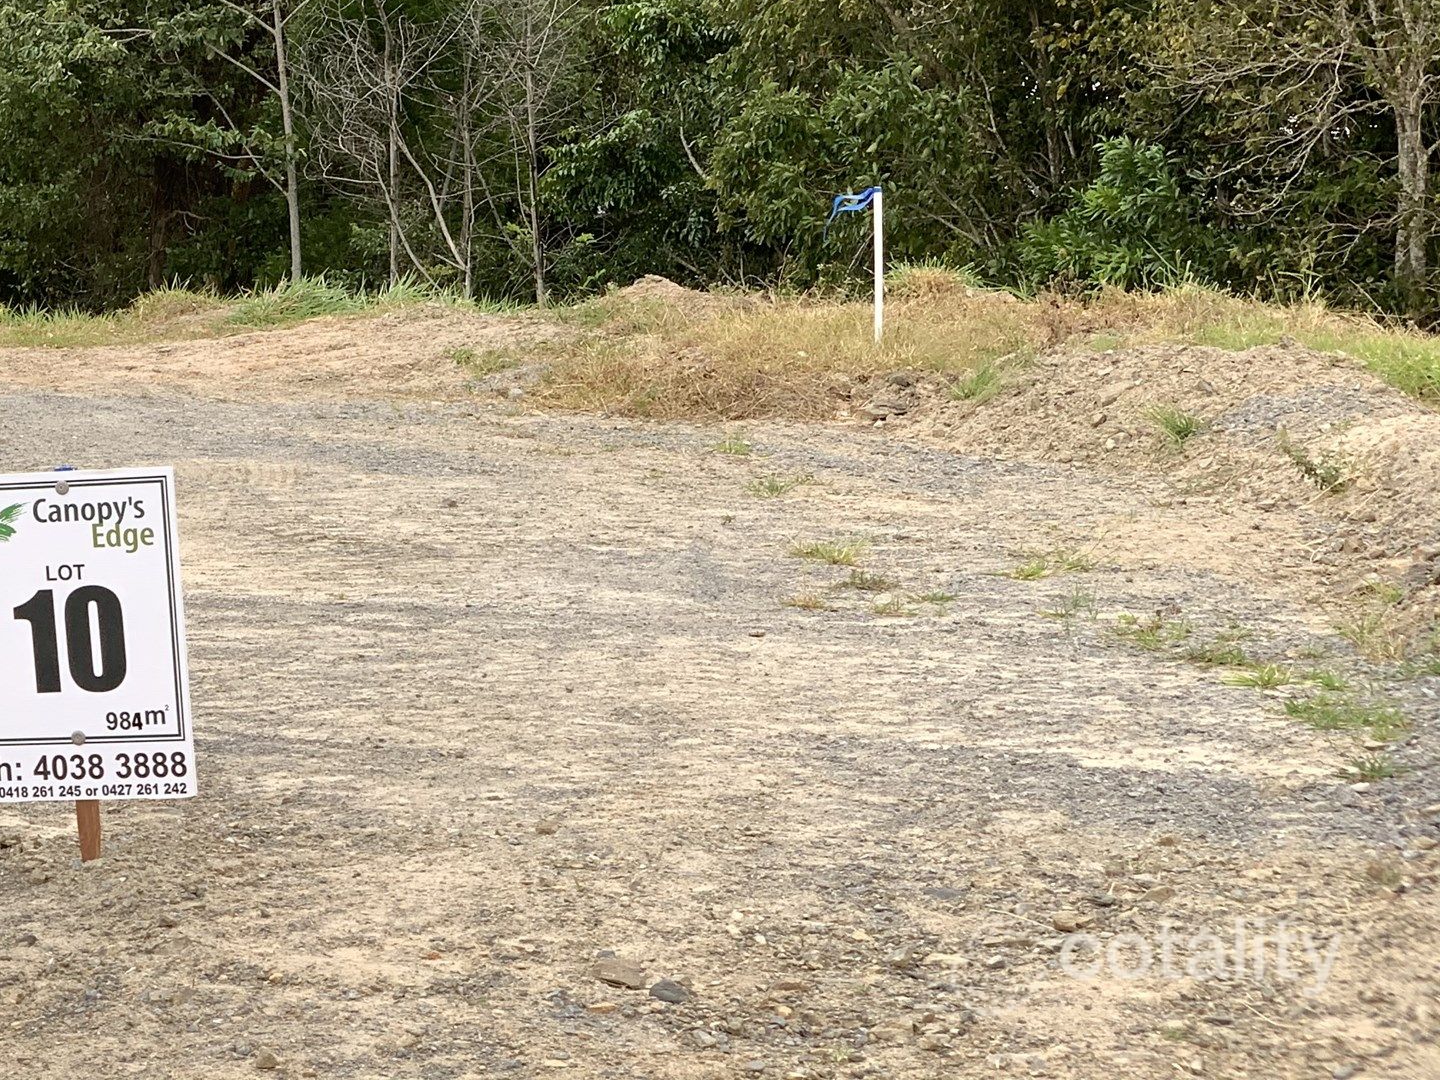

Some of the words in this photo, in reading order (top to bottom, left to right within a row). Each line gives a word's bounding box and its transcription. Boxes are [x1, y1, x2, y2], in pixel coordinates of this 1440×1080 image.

[33, 496, 145, 524] Canopy's
[92, 522, 154, 553] Edge
[45, 564, 85, 581] LOT
[13, 585, 127, 693] 10
[33, 753, 105, 780] 4038
[115, 751, 188, 779] 3888
[32, 786, 54, 798] 261
[59, 785, 81, 797] 245
[85, 787, 98, 797] or
[102, 784, 132, 796] 0427
[137, 784, 159, 795] 261
[164, 783, 188, 794] 242
